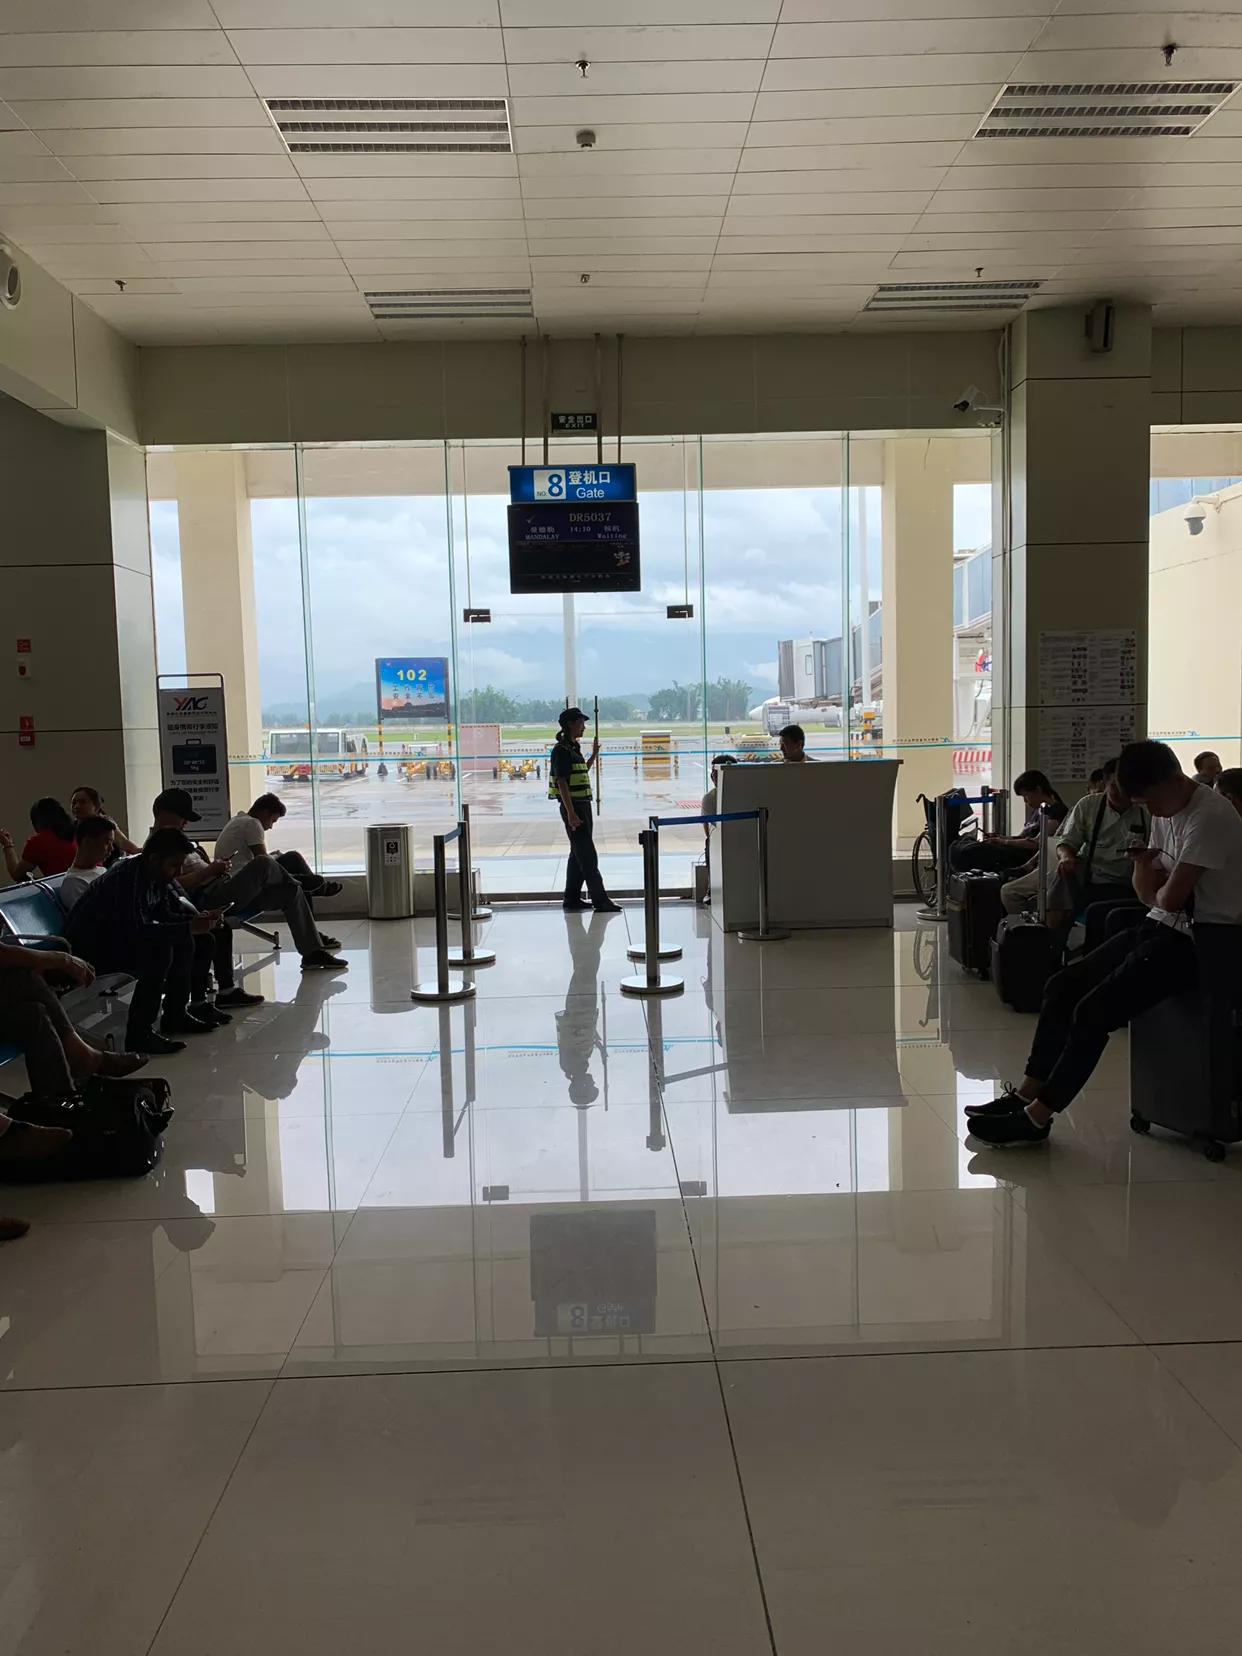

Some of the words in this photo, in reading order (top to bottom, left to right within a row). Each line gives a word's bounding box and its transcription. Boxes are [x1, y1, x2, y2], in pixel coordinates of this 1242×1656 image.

[558, 415, 592, 423] 安全出口
[568, 470, 611, 485] 登机口
[547, 473, 564, 498] 8
[576, 487, 605, 499] Gate
[569, 512, 612, 522] DR5037
[397, 669, 427, 681] 102
